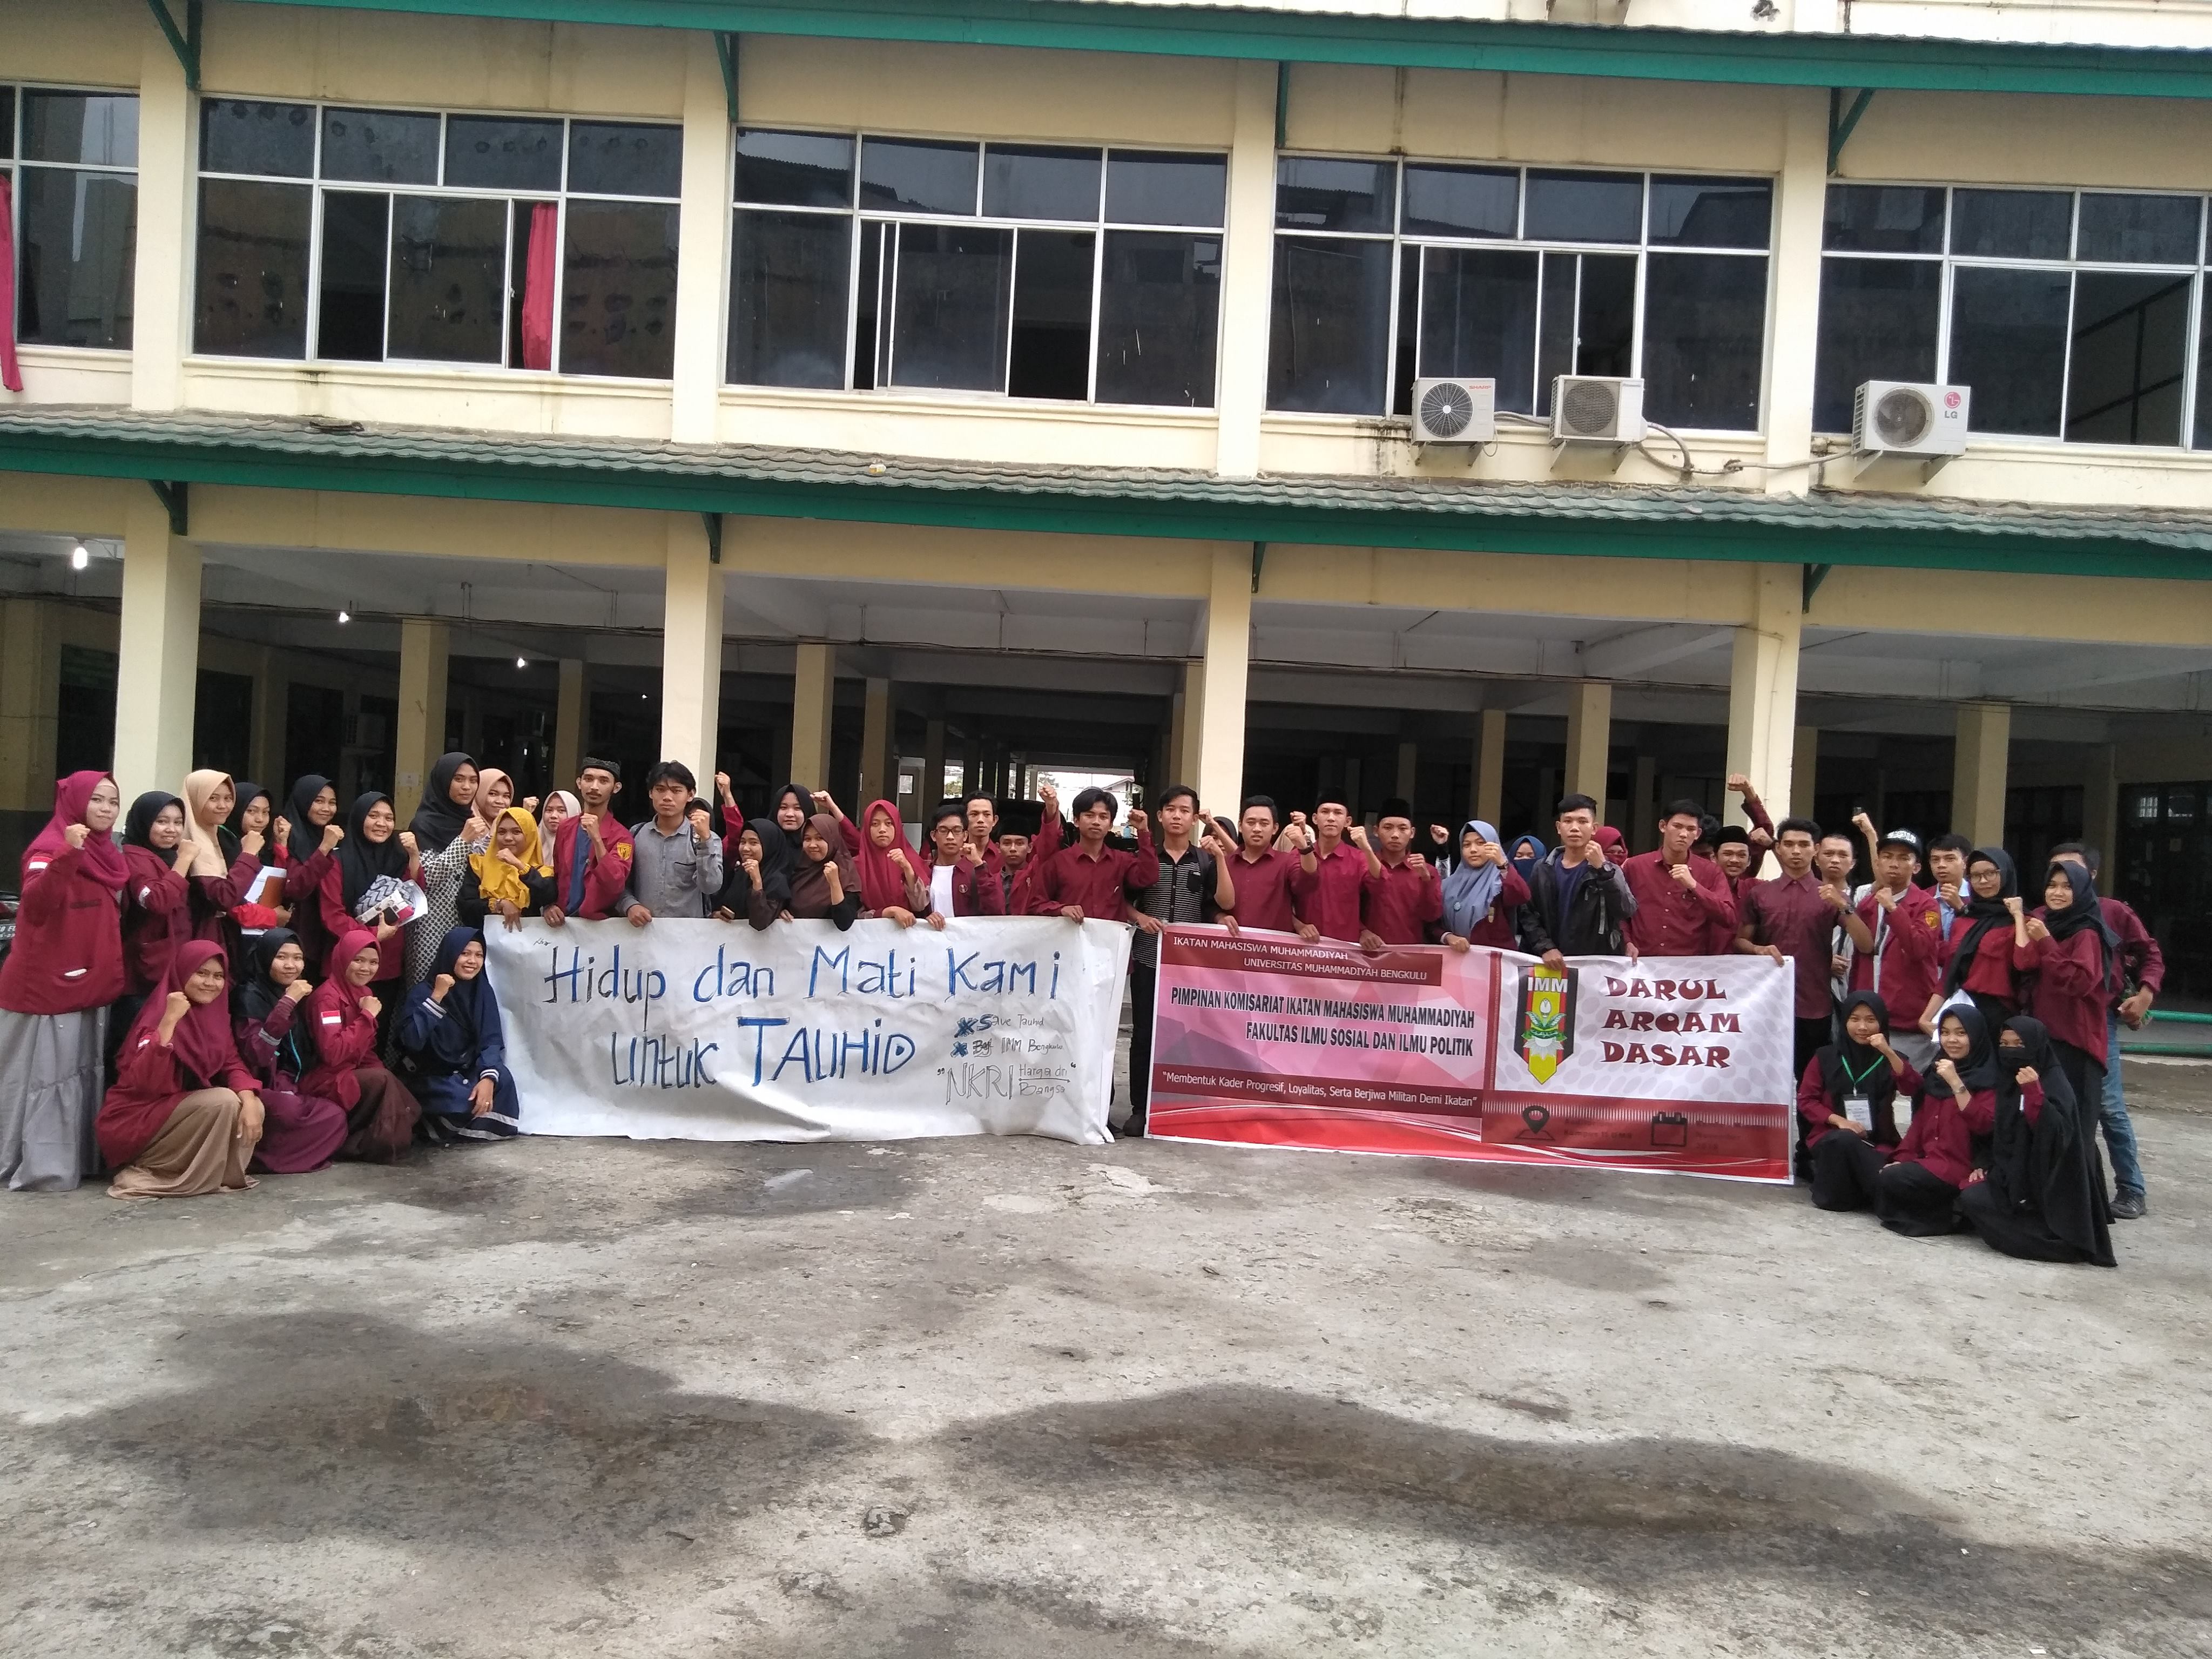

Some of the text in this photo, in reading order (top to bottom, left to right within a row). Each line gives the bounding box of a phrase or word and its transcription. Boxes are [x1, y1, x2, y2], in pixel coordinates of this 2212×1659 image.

[1944, 410, 1958, 419] LG
[1174, 936, 1348, 960] IKATAN MAHASISWA MUHAMMADIYAH
[1244, 957, 1427, 980] UNIVERSITAS MUHAMMADIYAH BENGKULU
[543, 943, 1061, 1032] Hidup dan Mati Kami
[1527, 976, 1567, 993] IMM
[1603, 975, 1728, 1001] DARUL
[1171, 987, 1475, 1028] PIMPINAN KOMISARIAT IKATAN MAHASISWA MUHAMMADIYAH
[1602, 1009, 1743, 1036] ARQAM
[1002, 1037, 1022, 1054] IMM
[1246, 1021, 1474, 1057] FAKULTAS ILMU SOSIAL DAN ILMU POLITIK
[1600, 1040, 1731, 1069] DASAR
[1019, 1064, 1051, 1078] Harga
[1219, 1076, 1244, 1088] Kader
[1246, 1079, 1286, 1094] Progresif,
[1289, 1082, 1327, 1097] Loyalitas,
[1330, 1086, 1351, 1097] Serta
[1354, 1088, 1385, 1101] Berjiwa
[1388, 1090, 1417, 1103] Militan
[1419, 1094, 1442, 1104] Demi
